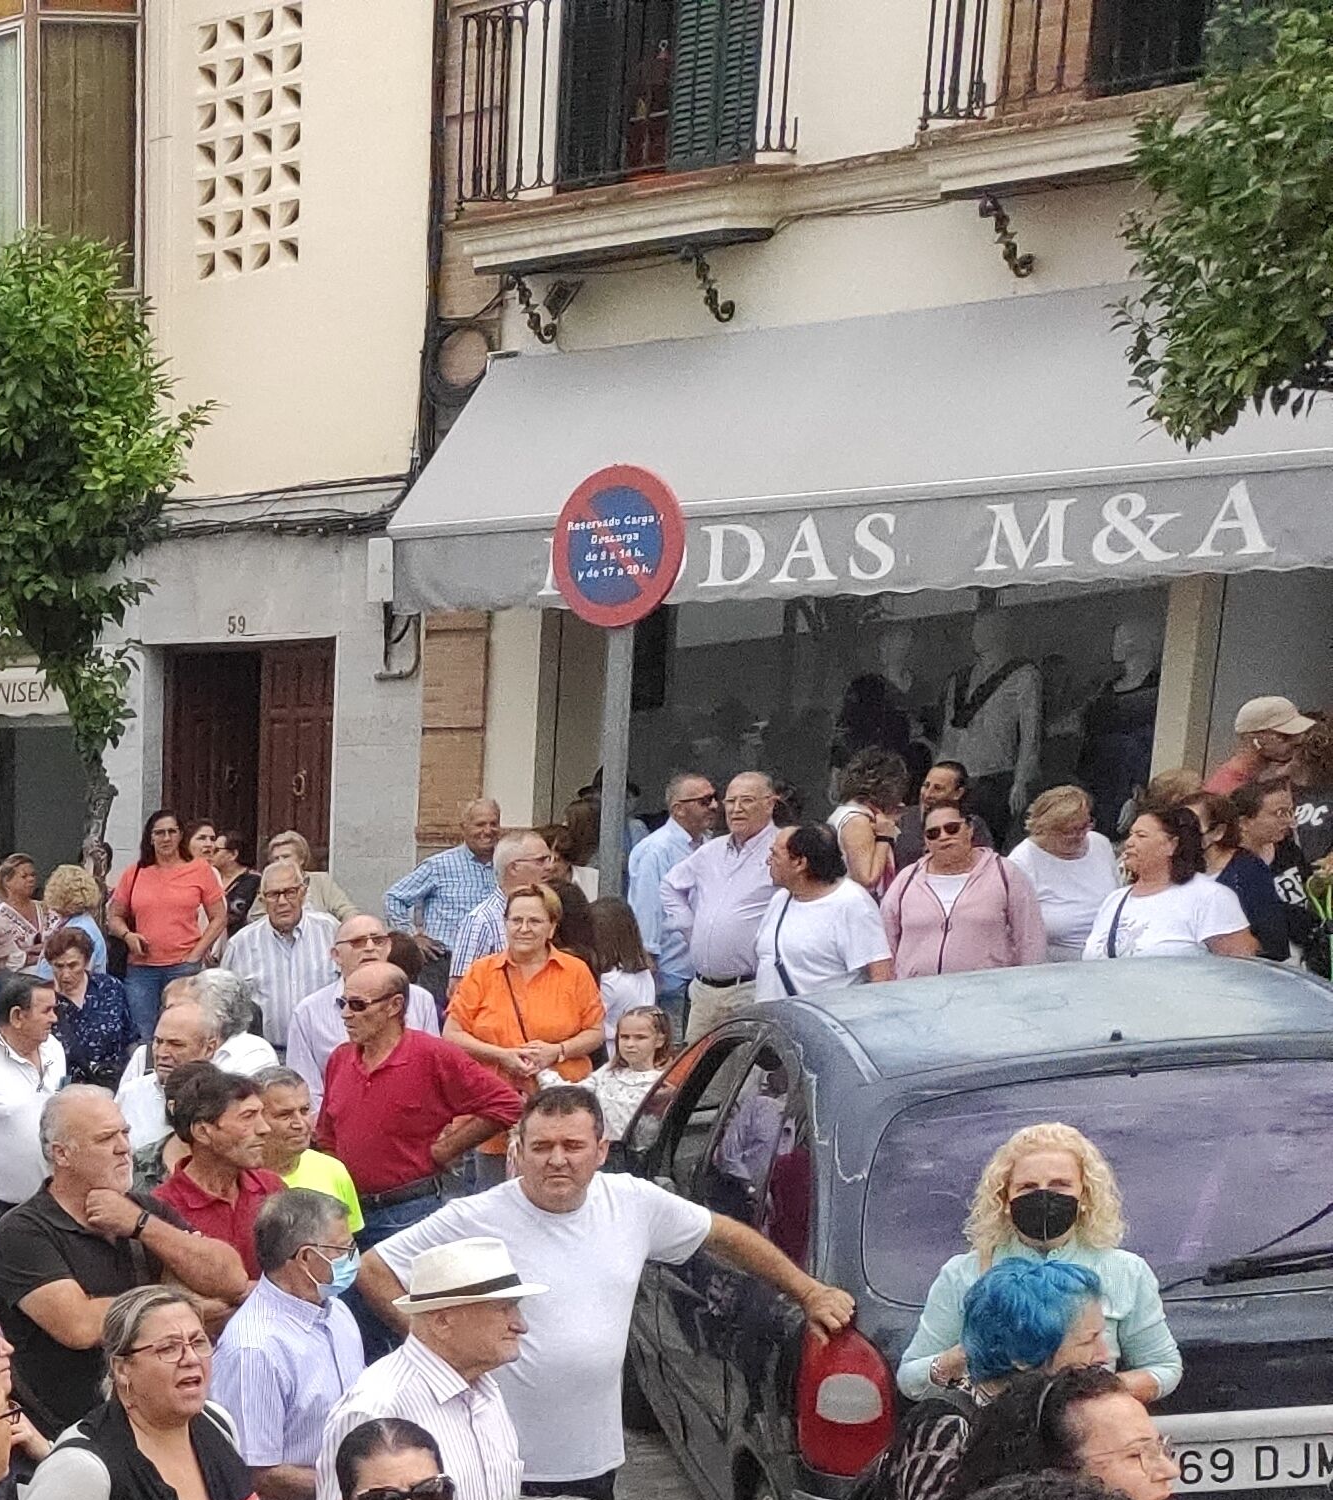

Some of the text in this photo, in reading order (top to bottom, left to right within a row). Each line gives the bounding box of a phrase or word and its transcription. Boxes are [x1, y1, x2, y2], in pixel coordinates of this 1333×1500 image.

[624, 514, 655, 526] Carga
[975, 480, 1277, 573] M&A
[591, 533, 640, 544] Descarga
[585, 552, 598, 562] de
[619, 548, 632, 558] 14
[578, 571, 584, 582] y
[586, 569, 599, 578] de
[602, 566, 613, 577] 17
[617, 567, 624, 576] a
[627, 565, 639, 575] 20
[228, 616, 246, 635] 59
